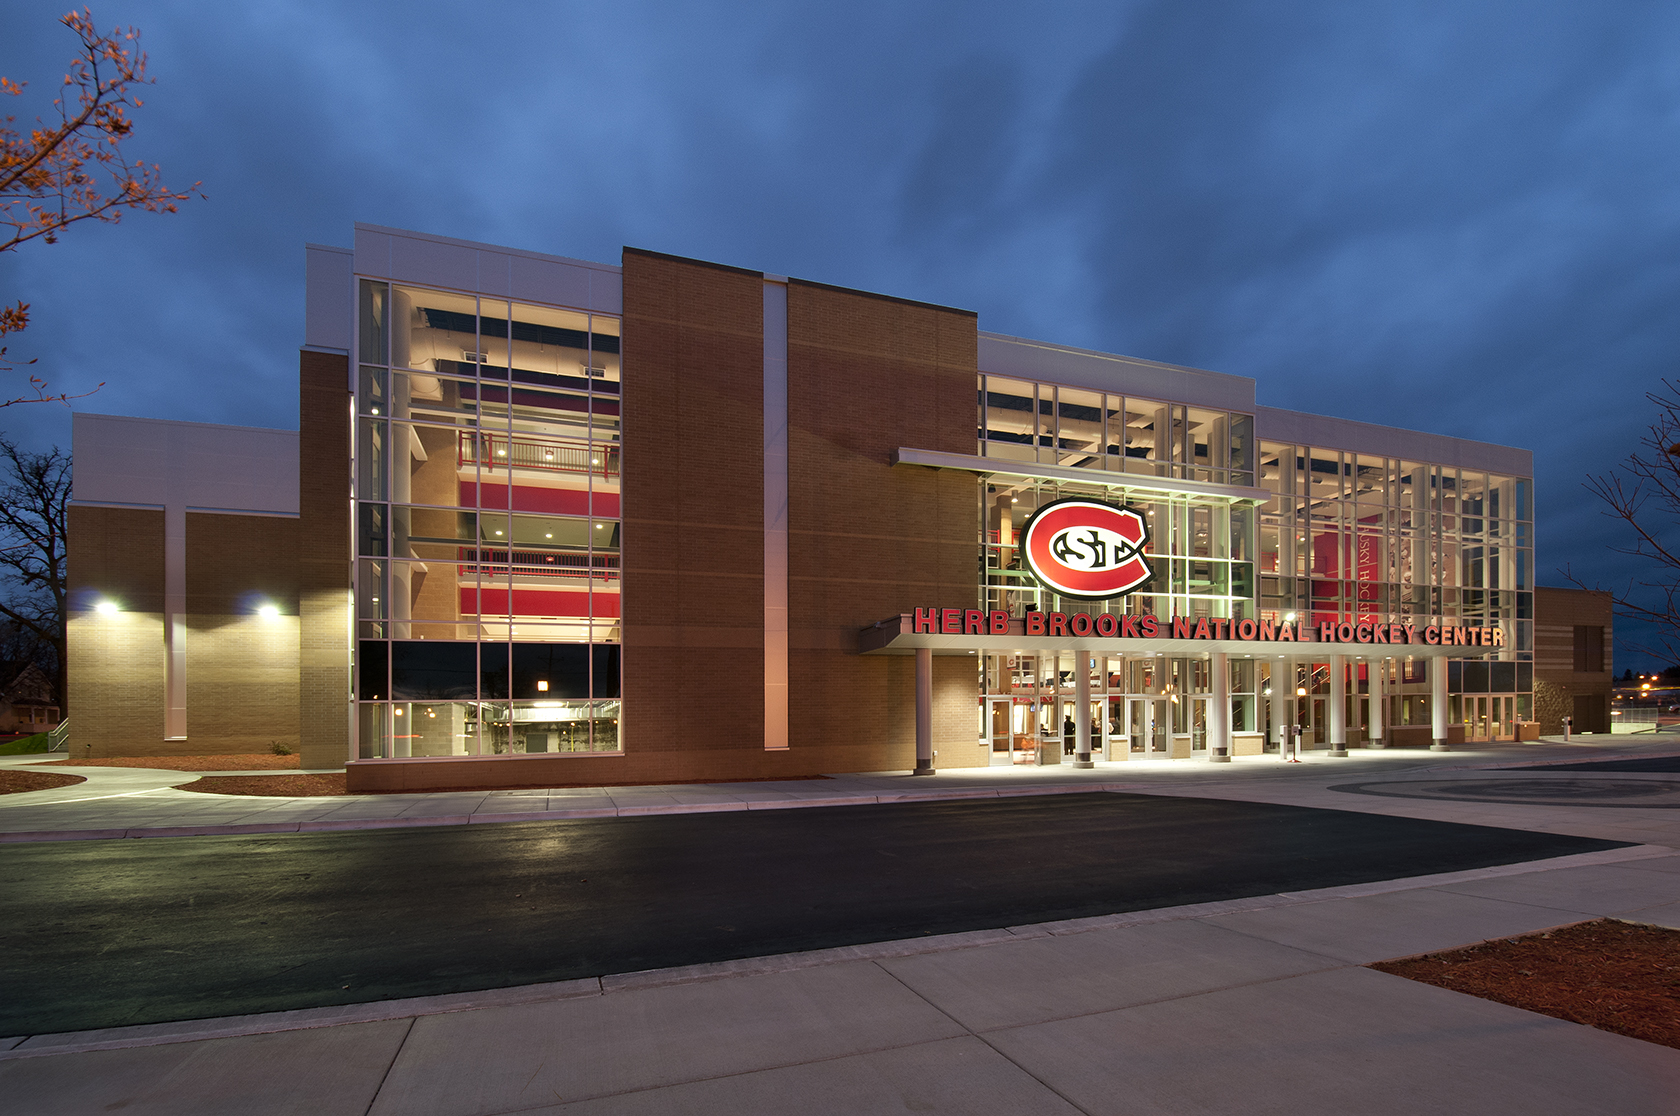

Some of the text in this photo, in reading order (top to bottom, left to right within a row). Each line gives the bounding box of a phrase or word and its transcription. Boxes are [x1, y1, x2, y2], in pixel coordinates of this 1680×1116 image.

[914, 606, 1504, 647] HERB BROOKS NATIONAL HOCKEY CENTER
